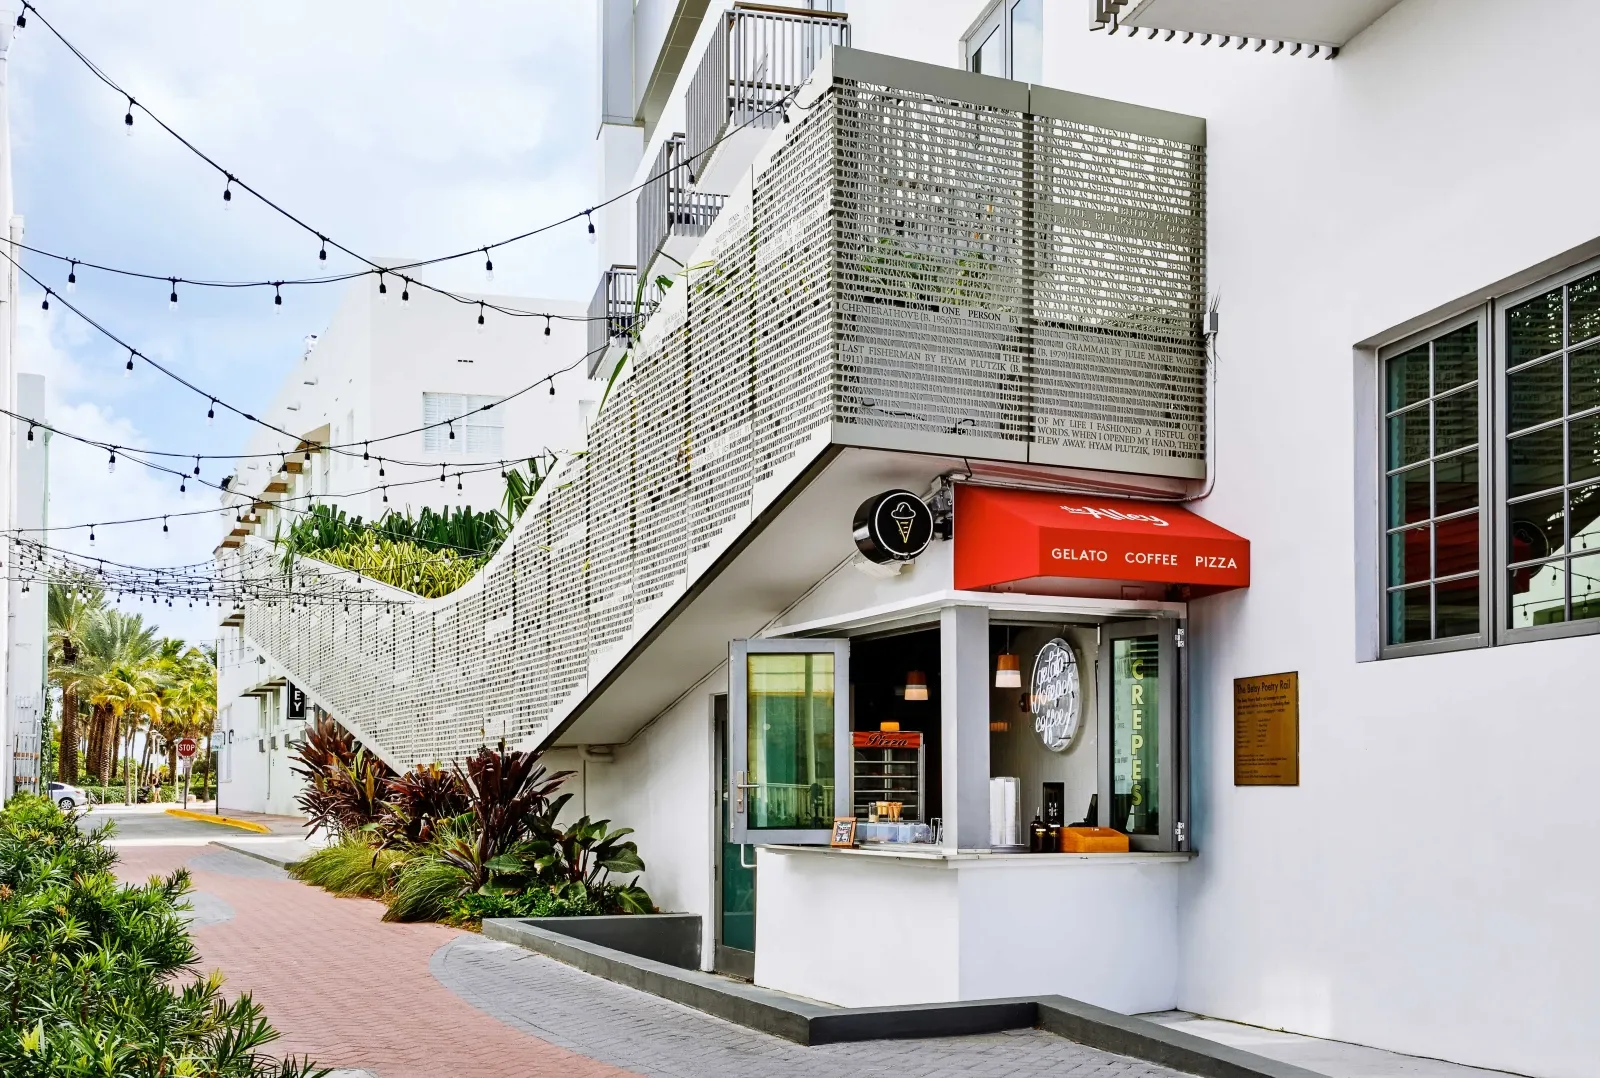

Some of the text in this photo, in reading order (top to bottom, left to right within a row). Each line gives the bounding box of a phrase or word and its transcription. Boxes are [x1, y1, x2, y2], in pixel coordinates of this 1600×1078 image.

[841, 302, 892, 316] CHENJERAI
[893, 309, 920, 320] HOVE
[941, 306, 960, 315] ONE
[968, 309, 1000, 321] PERSON
[1009, 315, 1020, 323] BY
[841, 343, 864, 353] LAST
[868, 346, 921, 360] FISHERMAN
[925, 353, 936, 362] BY
[940, 355, 966, 366] HYAM
[970, 359, 1007, 371] PLUTZIK
[1002, 353, 1020, 362] THE
[1065, 342, 1198, 366] GRAMMAR BY JULIE MARIE WADE
[1037, 416, 1048, 424] OF
[1052, 417, 1065, 426] MY
[1069, 419, 1086, 428] LIFE
[1096, 422, 1142, 434] FASHIONED
[1154, 429, 1184, 439] FISTFUL
[1187, 433, 1198, 441] OF
[1181, 423, 1198, 431] OUT
[1037, 436, 1059, 445] FLEW
[1088, 441, 1112, 450] HYAM
[1152, 448, 1167, 456] 1911
[1071, 429, 1096, 439] WHEN
[1103, 433, 1135, 443] OPENED
[1137, 436, 1149, 445] MY
[1178, 441, 1198, 450] THEY
[1082, 506, 1169, 527] Alley
[1051, 548, 1238, 569] GELATO COFFEE PIZZA
[1236, 684, 1246, 694] The
[1262, 682, 1279, 694] Poetry
[1280, 679, 1291, 690] Rail
[1036, 709, 1069, 744] coffee
[1131, 659, 1144, 806] CREPES
[865, 732, 908, 746] Pizza
